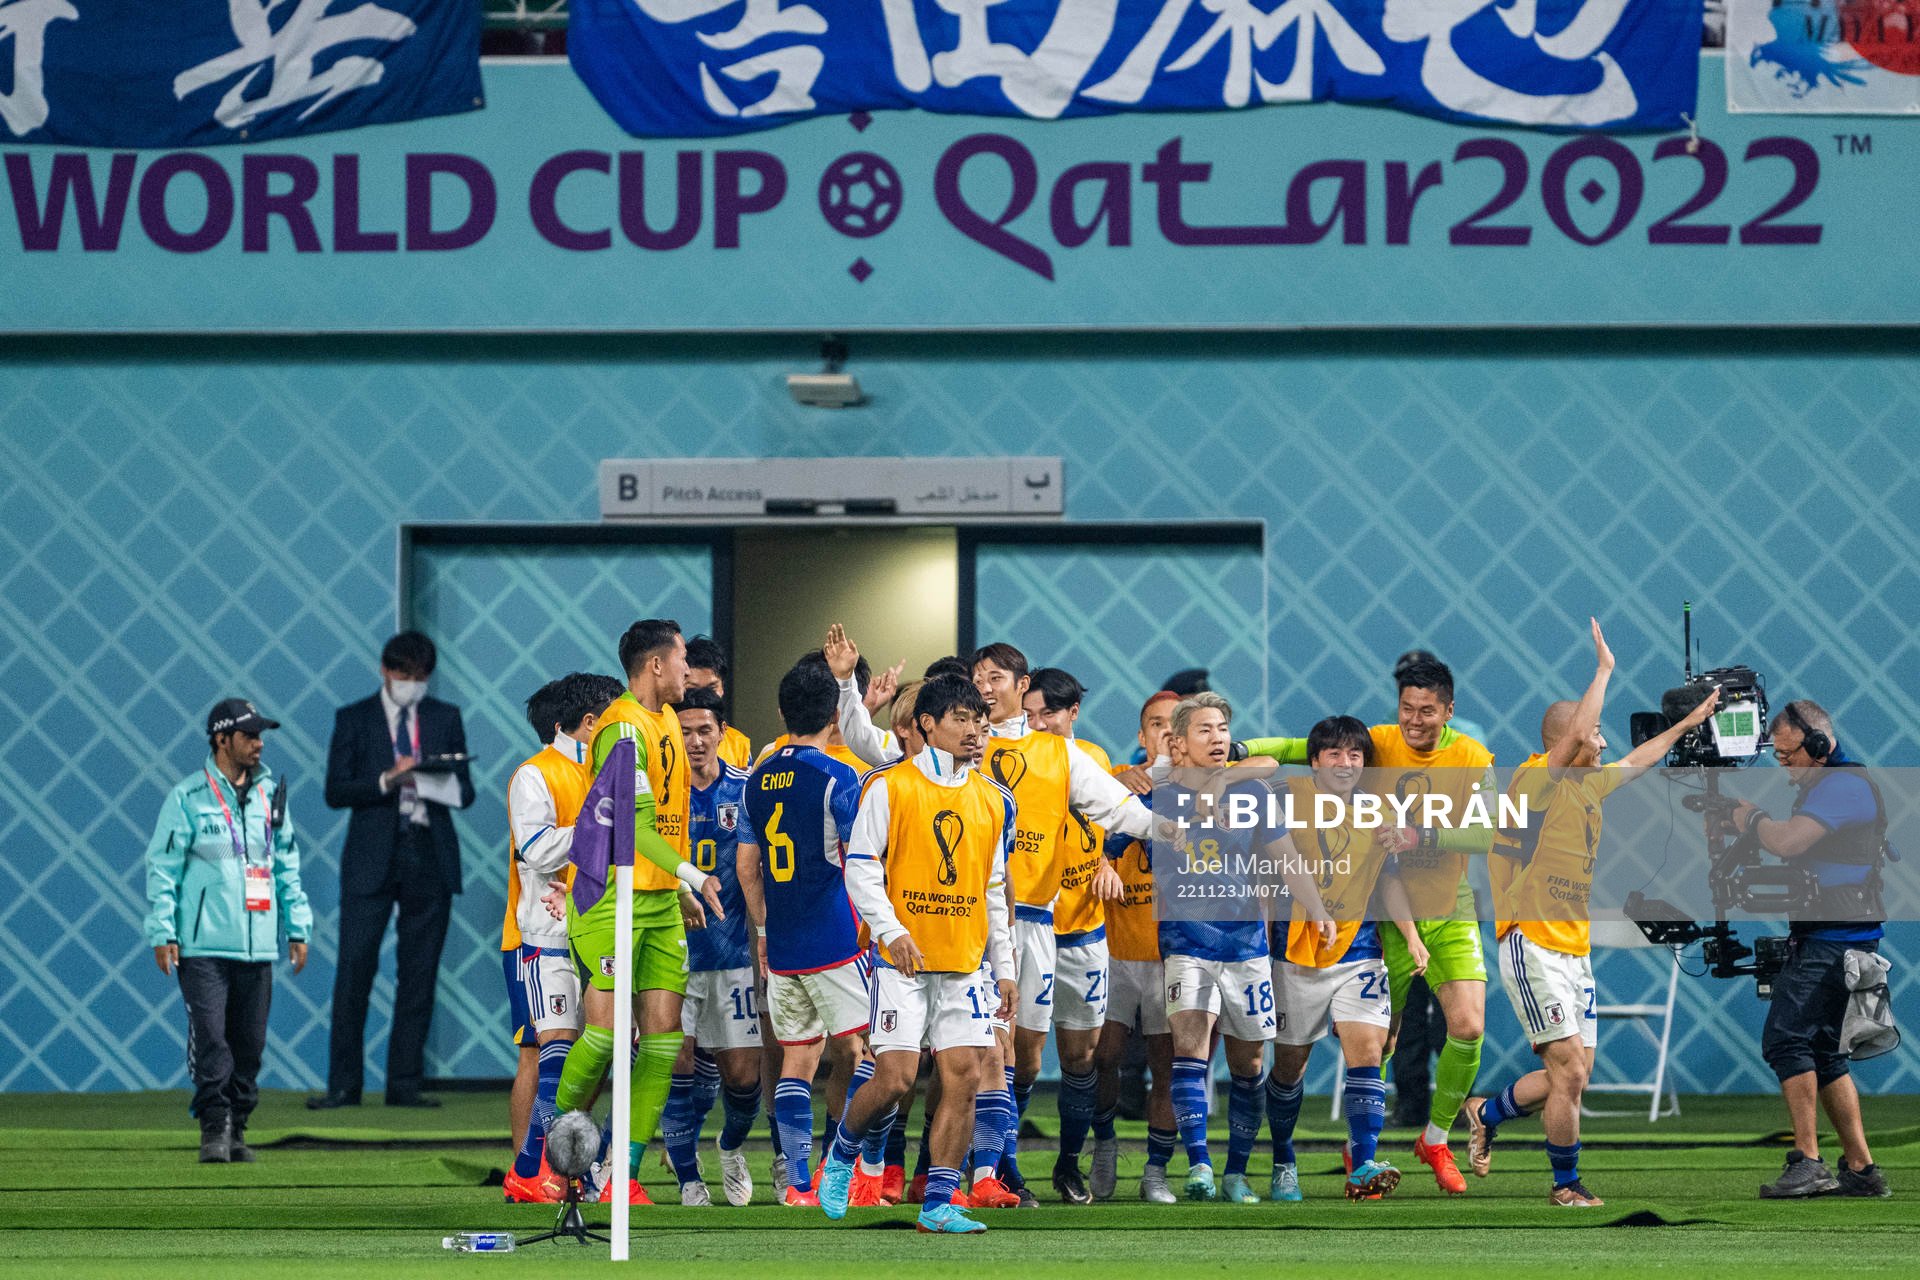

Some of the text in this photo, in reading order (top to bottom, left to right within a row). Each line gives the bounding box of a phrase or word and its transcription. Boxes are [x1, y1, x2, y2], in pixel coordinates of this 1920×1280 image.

[4, 152, 498, 254] WORLD
[529, 149, 789, 253] CUP
[618, 473, 639, 501] B
[662, 485, 762, 501] Pitch Access
[761, 771, 795, 791] ENDO
[764, 802, 796, 883] 6
[1547, 875, 1570, 889] FIFA
[902, 889, 927, 902] FIFA
[928, 893, 965, 905] WORLD
[730, 986, 758, 1020] 10
[1243, 980, 1274, 1016] 18
